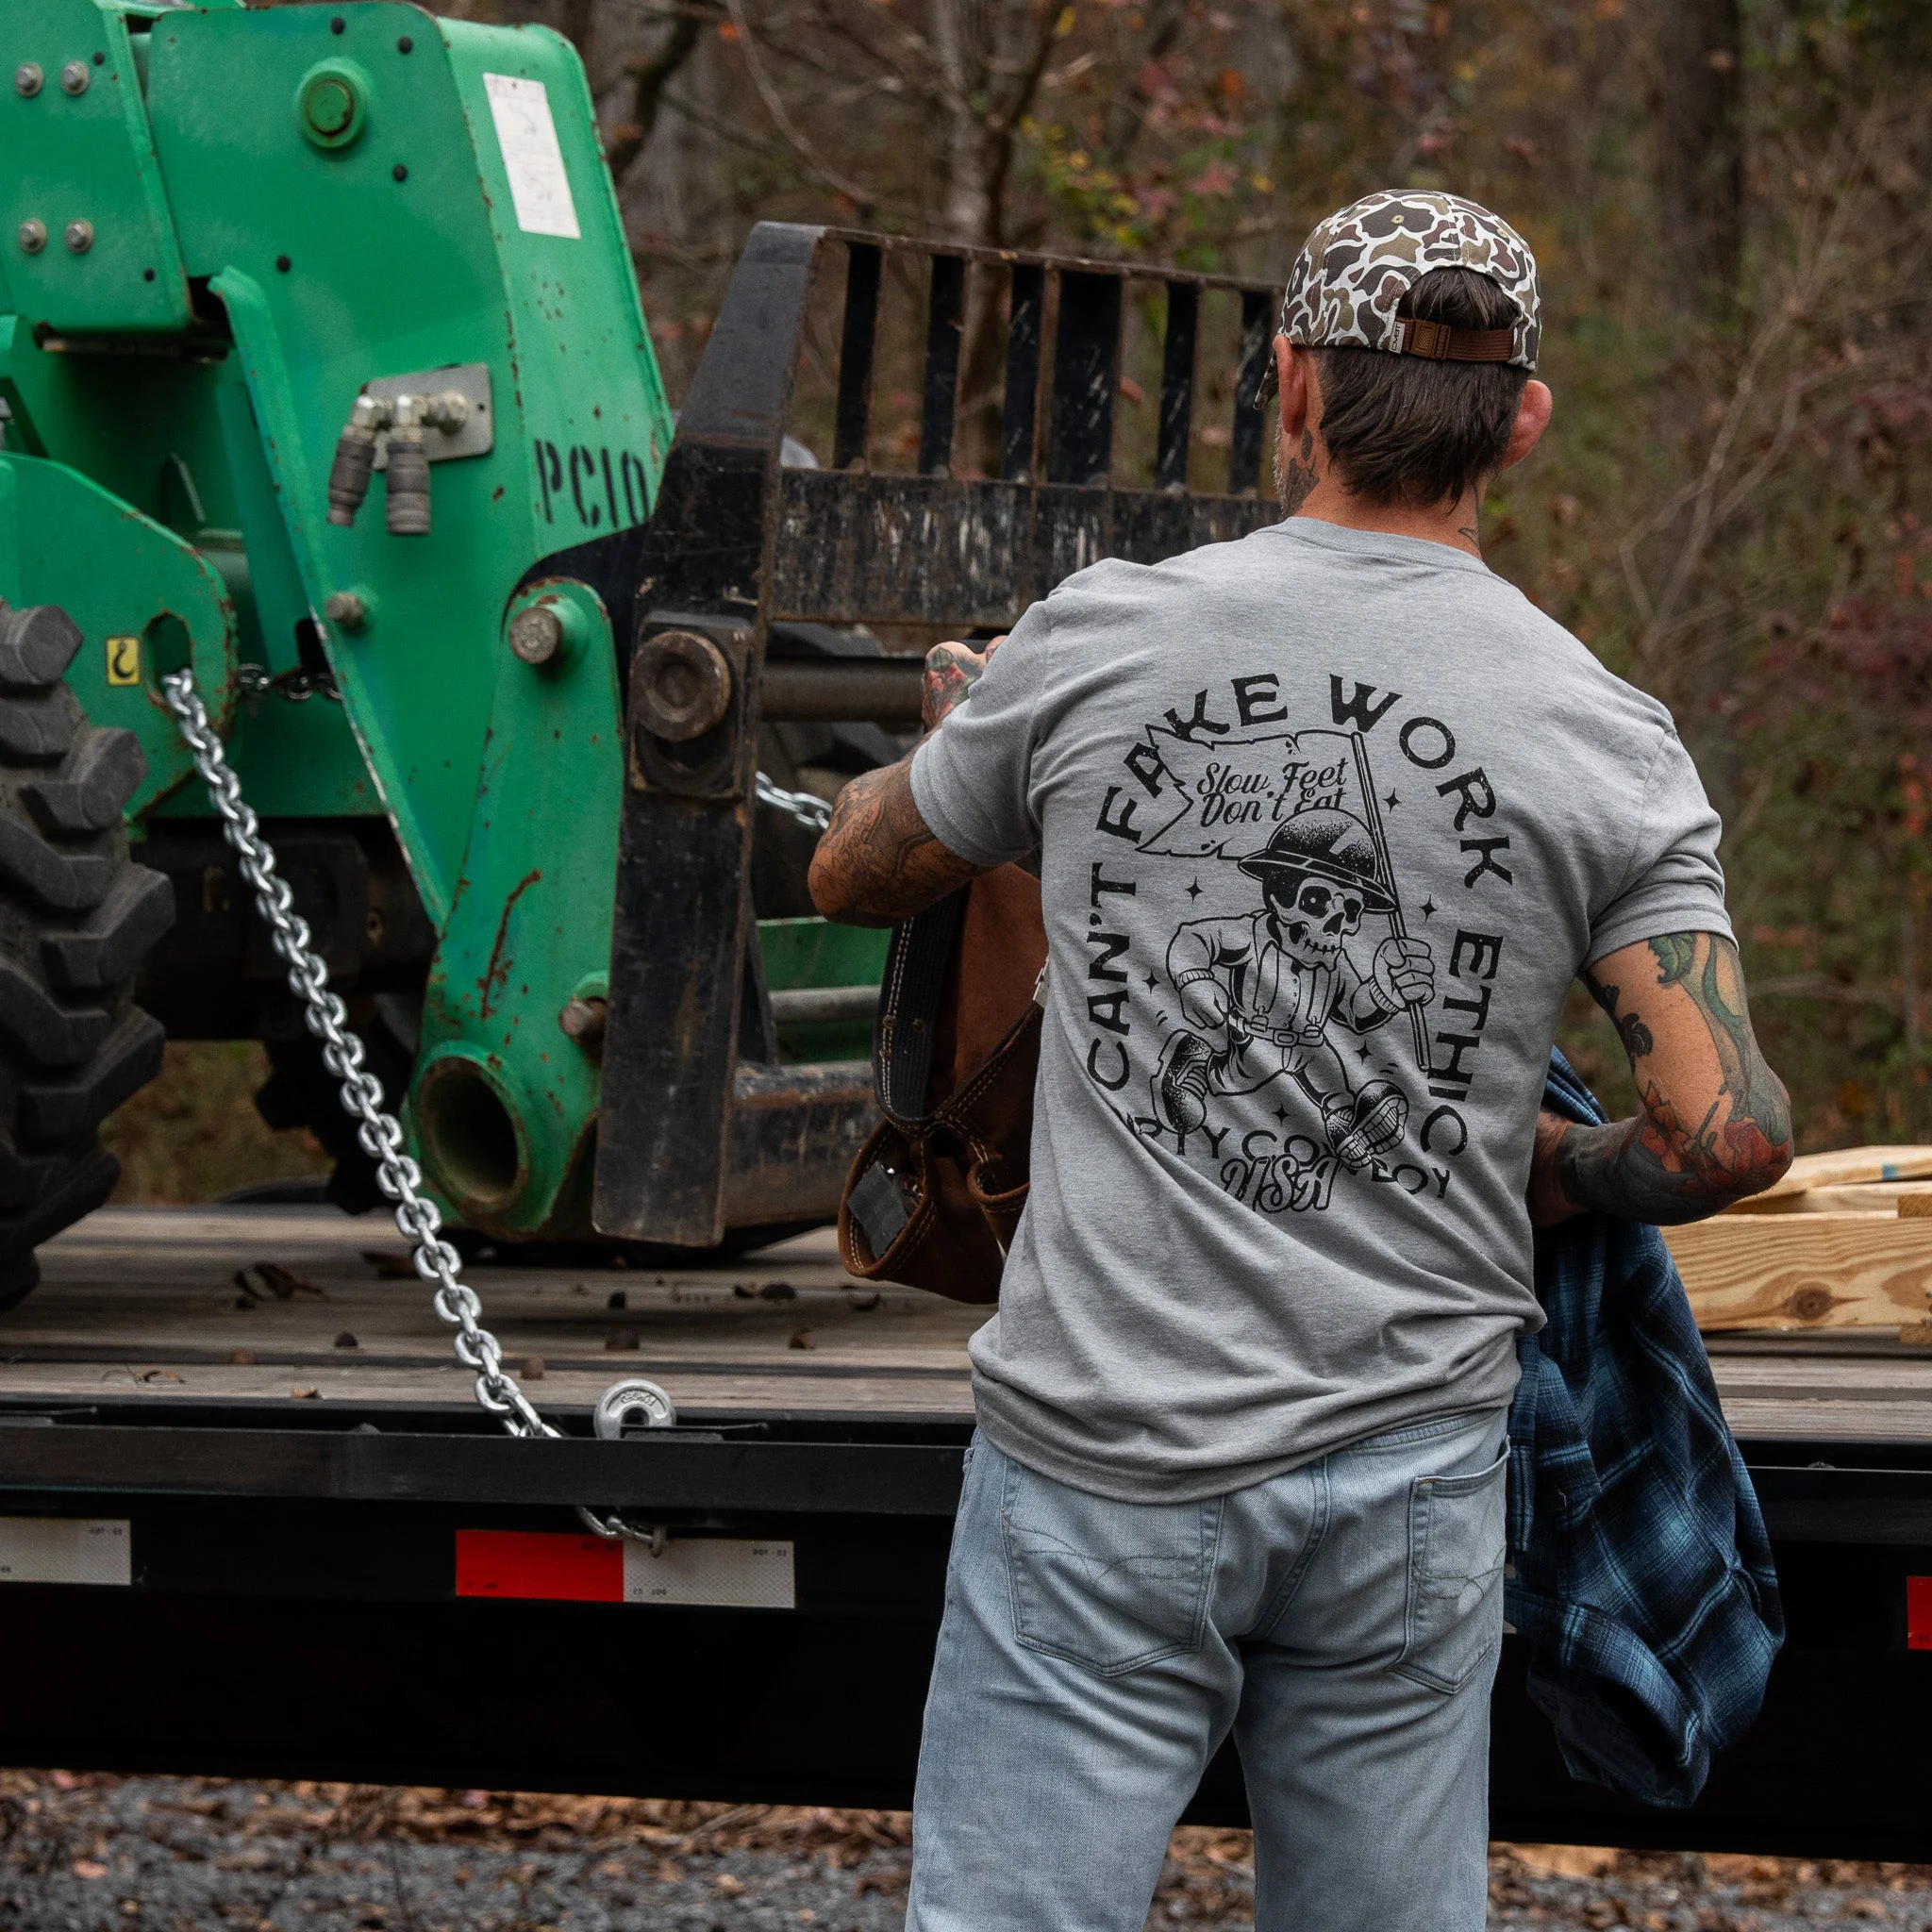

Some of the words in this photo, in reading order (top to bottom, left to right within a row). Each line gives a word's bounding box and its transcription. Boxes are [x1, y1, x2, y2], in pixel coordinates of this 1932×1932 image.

[1096, 673, 1289, 844] FAKE
[1196, 761, 1272, 795] Slow
[1282, 758, 1349, 794] Feet
[1200, 790, 1287, 827] Don't
[1293, 787, 1347, 815] Eat
[1328, 673, 1513, 889] WORK
[1086, 861, 1137, 1091] CAN'T
[1420, 927, 1505, 1158] ETHIC
[1220, 1153, 1341, 1214] USA
